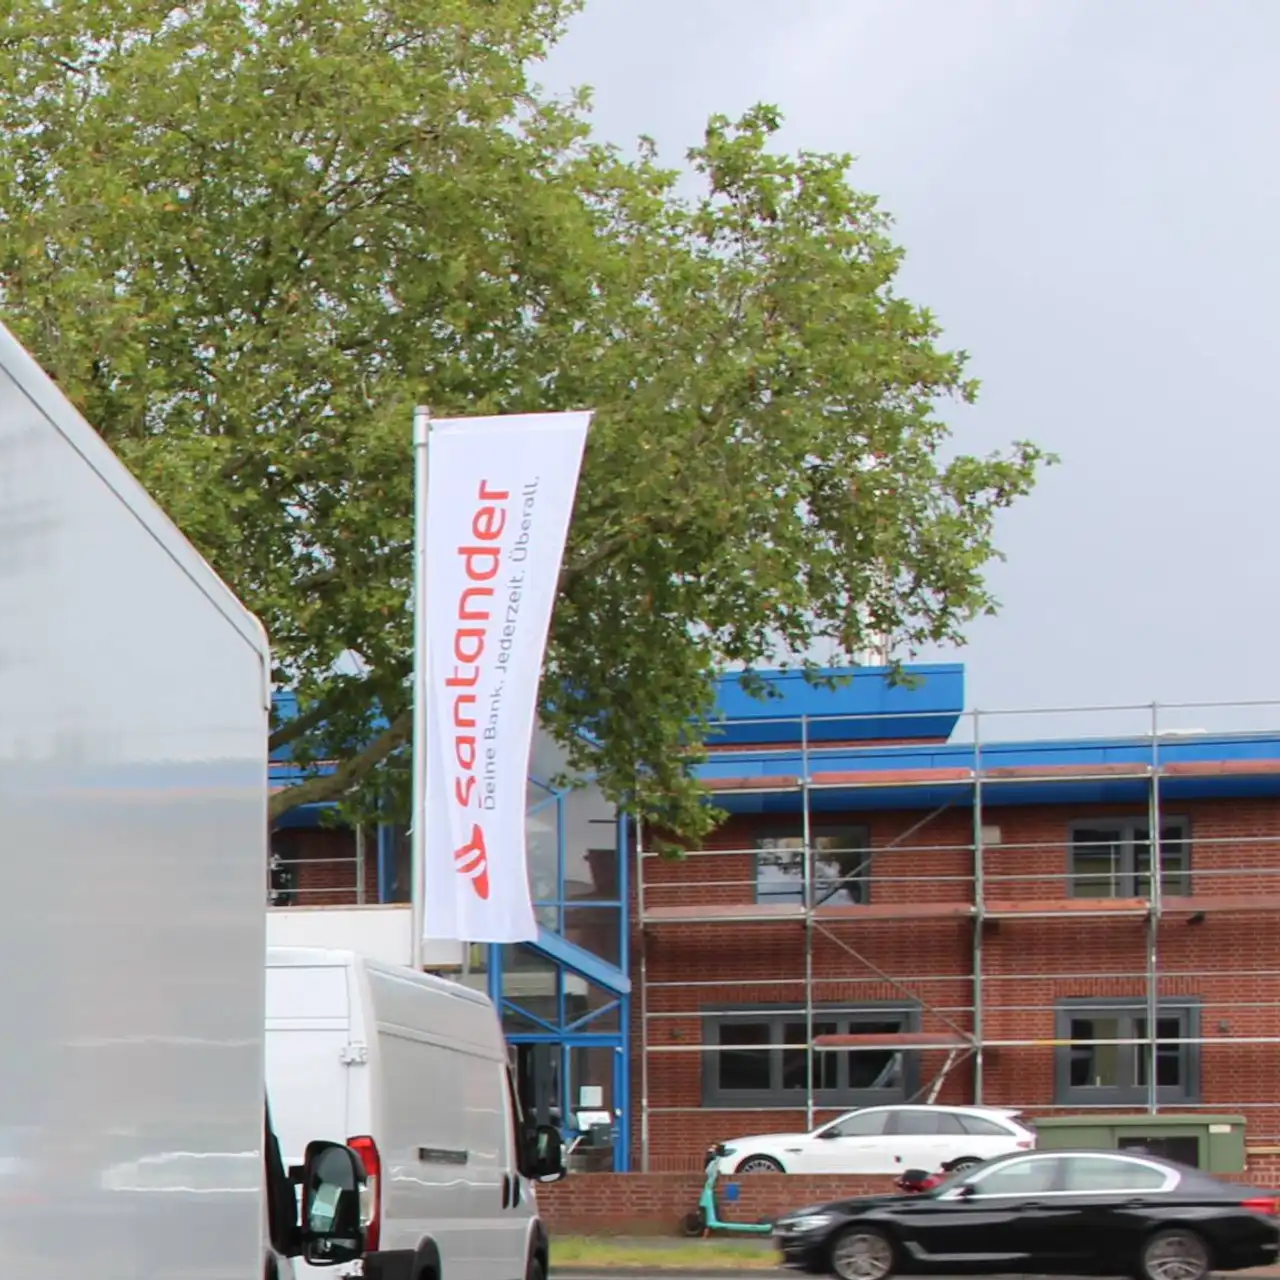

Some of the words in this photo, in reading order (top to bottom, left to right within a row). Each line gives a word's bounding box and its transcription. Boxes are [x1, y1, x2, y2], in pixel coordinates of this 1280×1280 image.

[508, 475, 540, 562] Überall.
[495, 570, 525, 673] Jederzeit.
[483, 679, 504, 740] Bank.
[483, 747, 497, 811] Deine
